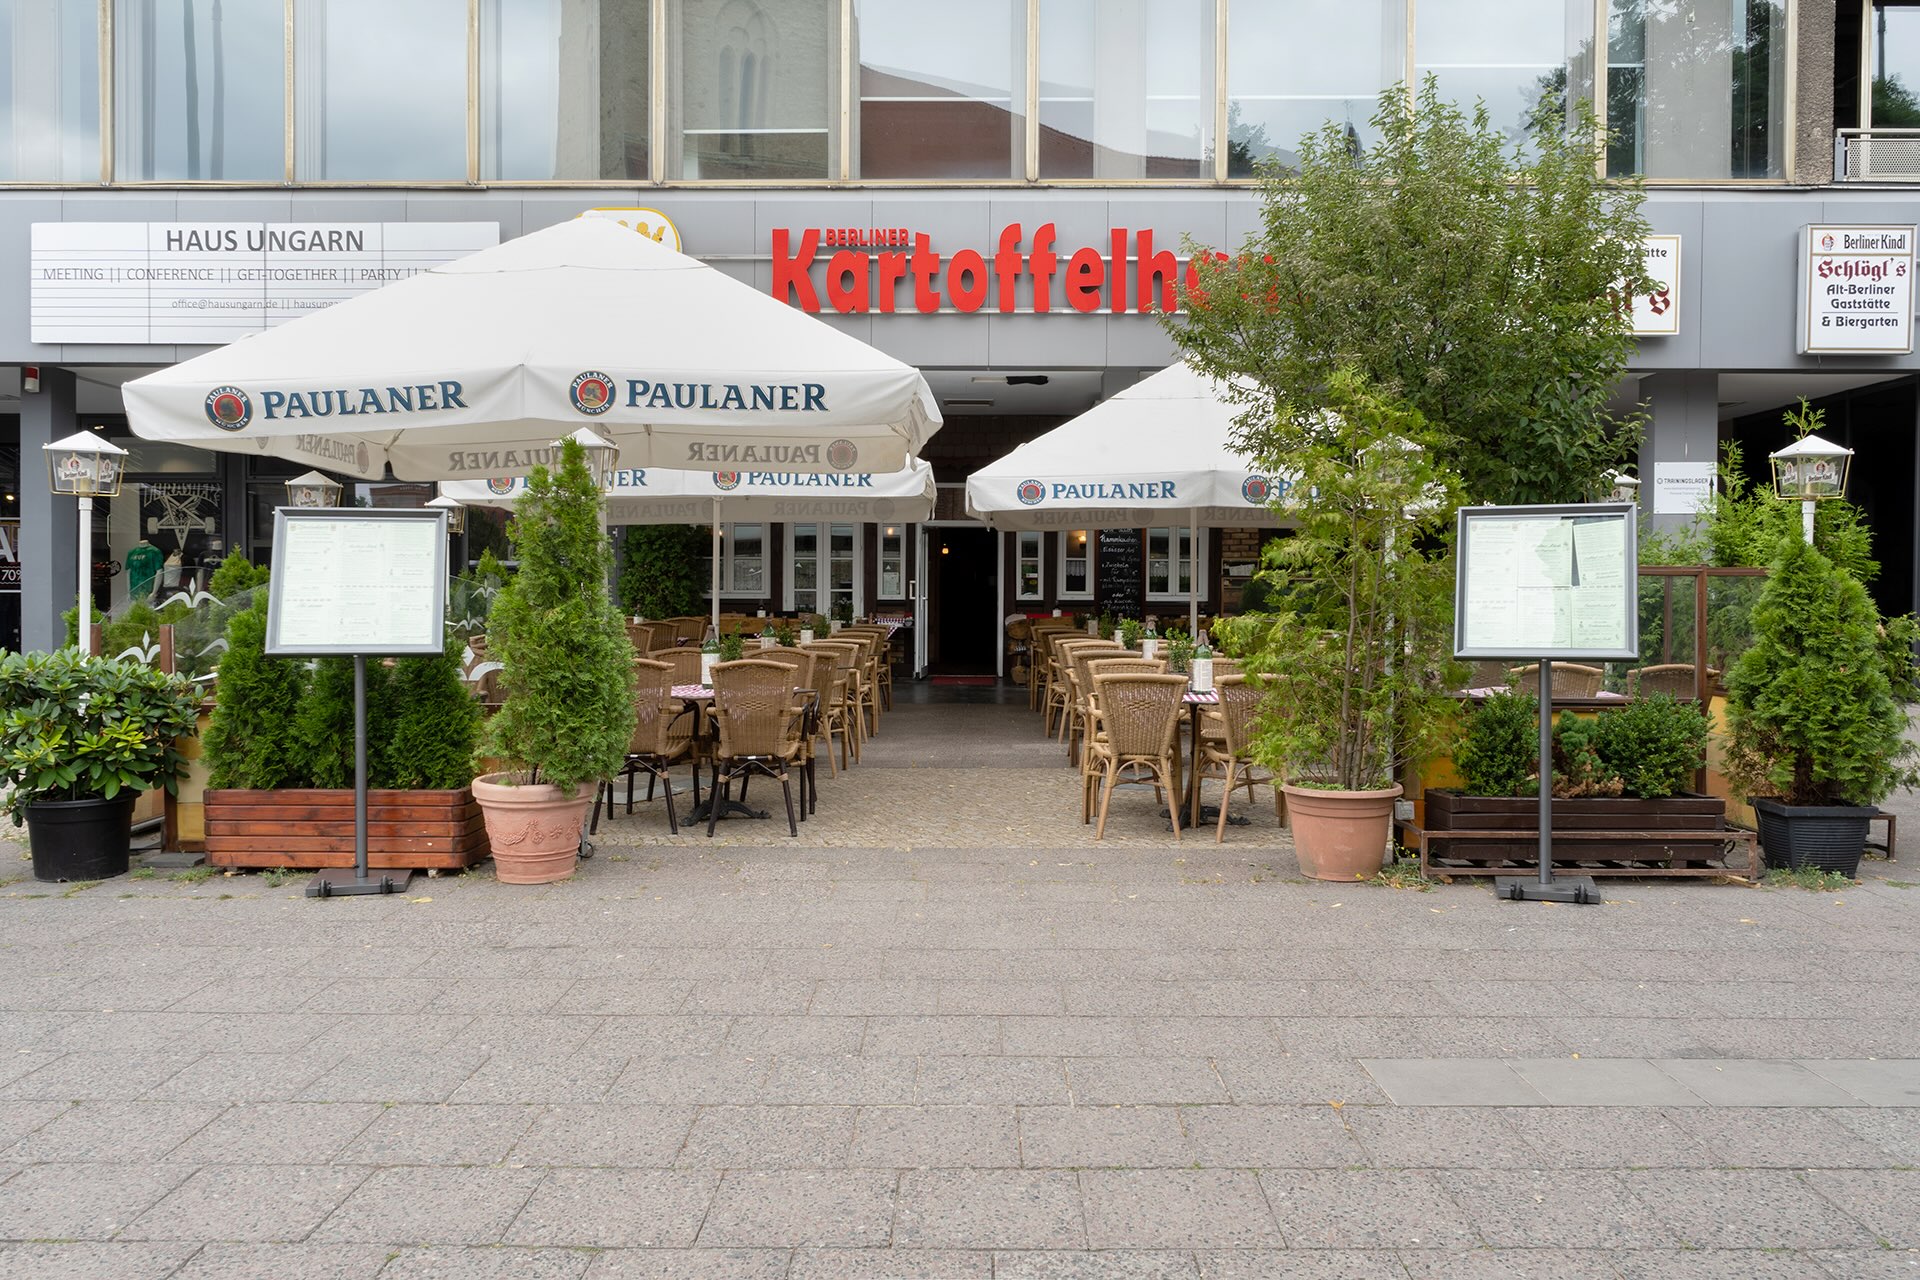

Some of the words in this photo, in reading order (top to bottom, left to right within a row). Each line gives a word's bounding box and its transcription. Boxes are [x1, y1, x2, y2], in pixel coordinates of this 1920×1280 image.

[166, 229, 238, 252] HAUS
[246, 229, 364, 252] UNGARN
[826, 228, 909, 247] BERLINER
[1843, 233, 1880, 250] Berliner
[1881, 233, 1906, 250] Kindl
[43, 267, 104, 281] MEETING
[126, 267, 215, 281] CONFERENCE
[237, 267, 338, 281] GET-TOGETHER
[360, 268, 401, 281] PARTY
[772, 222, 1280, 314] Kartoffelh
[1826, 284, 1896, 296] Alt-Berliner
[171, 298, 278, 310] office@hausungarn.de
[1830, 298, 1891, 310] Gaststätte
[1821, 316, 1831, 328] &
[1835, 316, 1899, 330] Biergarten
[572, 371, 614, 389] PAULANER
[260, 380, 469, 420] PAULANER
[624, 379, 829, 412] PAULANER
[747, 471, 874, 488] PAULANER
[1052, 480, 1177, 500] PAULANER
